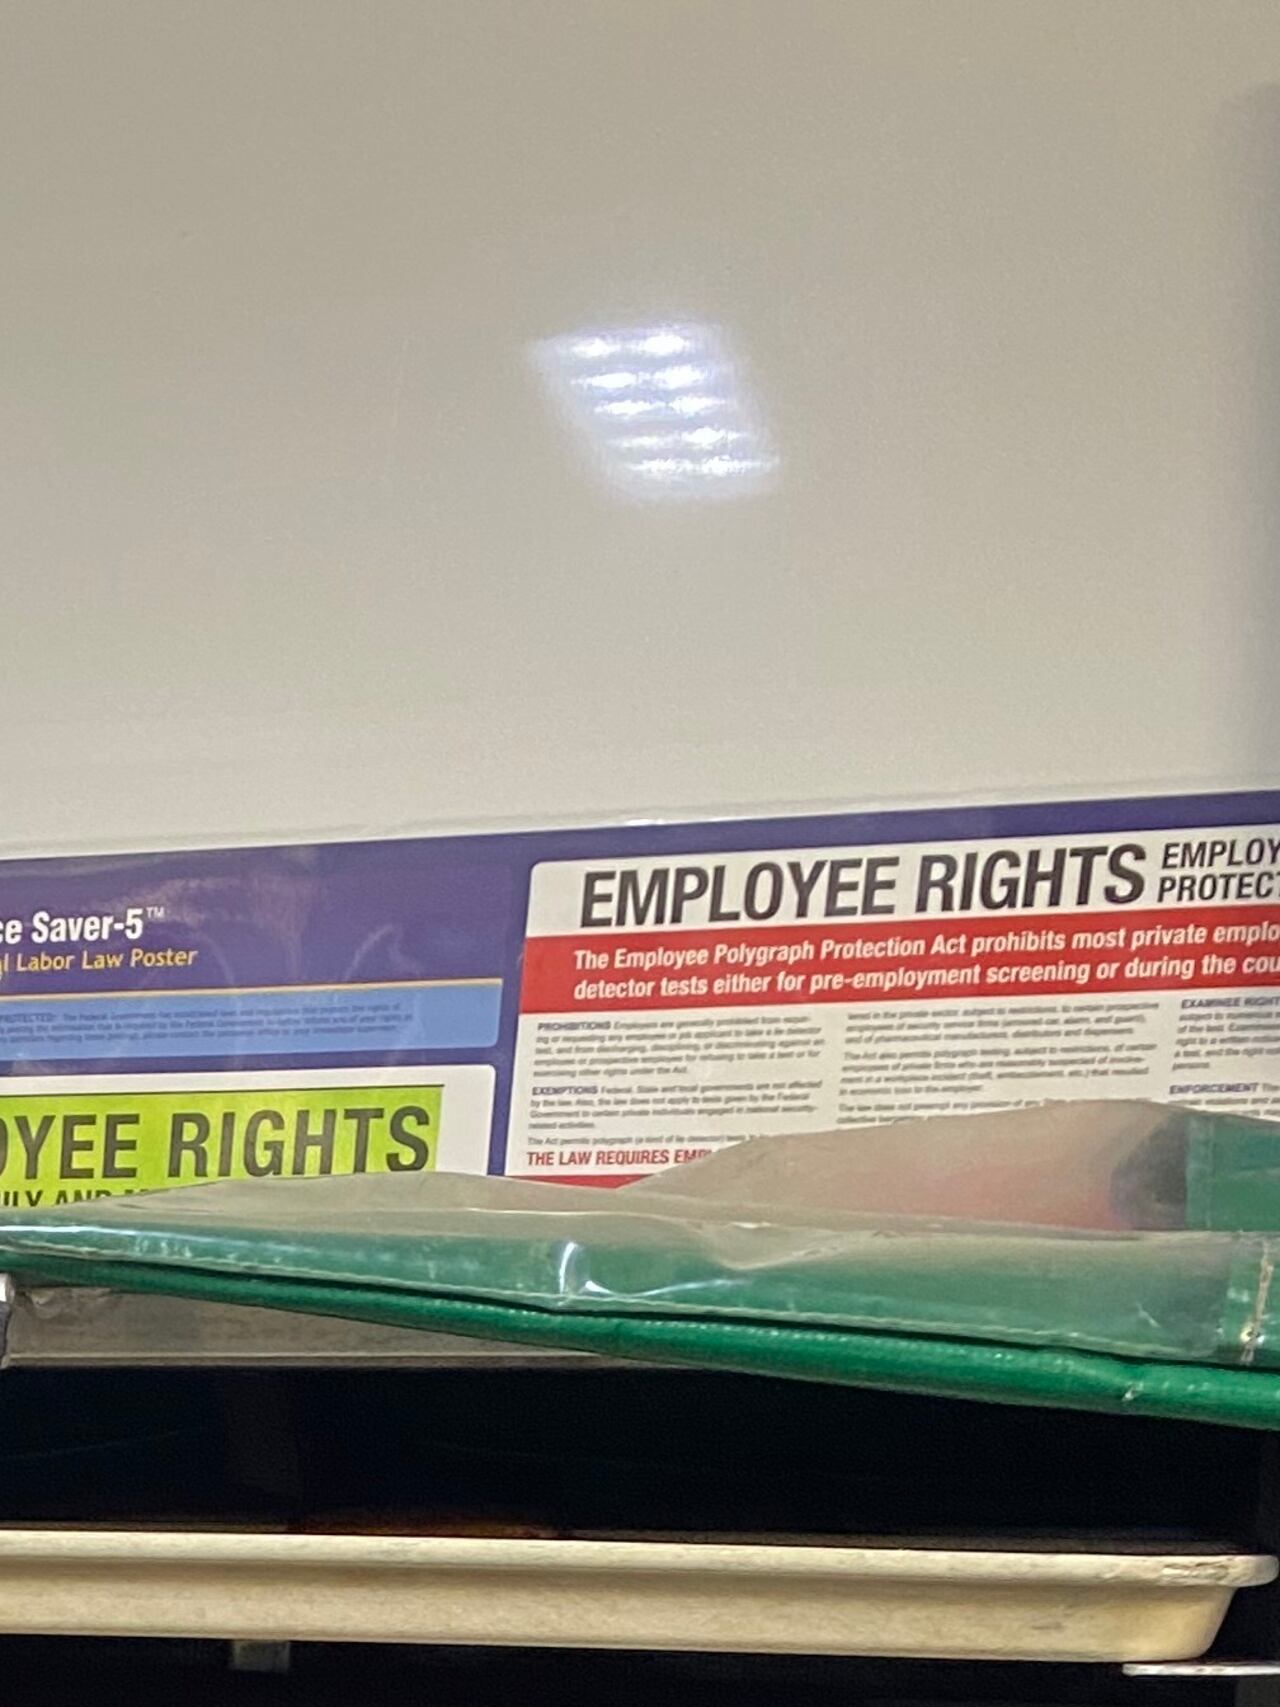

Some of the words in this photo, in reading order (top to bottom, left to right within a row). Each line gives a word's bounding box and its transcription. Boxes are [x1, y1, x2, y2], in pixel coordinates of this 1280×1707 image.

[578, 855, 901, 929] EMPLOYEE
[914, 843, 1147, 913] RIGHTS
[1157, 872, 1280, 903] PROTEC
[17, 951, 75, 972] Labor
[82, 949, 124, 970] Law
[130, 947, 198, 967] Poster
[574, 949, 610, 970] The
[614, 945, 709, 971] Employee
[714, 939, 814, 967] Polygraph
[820, 934, 925, 959] Protection
[930, 934, 966, 954] Act
[970, 929, 1066, 957] prohibits
[1072, 927, 1127, 950] most
[1131, 923, 1206, 947] private
[574, 978, 655, 1000] detector
[660, 975, 709, 995] tests
[713, 971, 772, 995] either
[777, 970, 805, 990] for
[809, 965, 981, 995] pre-employment
[986, 960, 1089, 984] screening
[1096, 960, 1120, 978] or
[1124, 955, 1195, 979] during
[1202, 953, 1236, 974] the
[168, 1104, 432, 1180] RIGHTS
[527, 1151, 554, 1165] THE
[559, 1151, 592, 1165] LAW
[596, 1149, 669, 1165] REQUIRES
[673, 1149, 712, 1164] EMP
